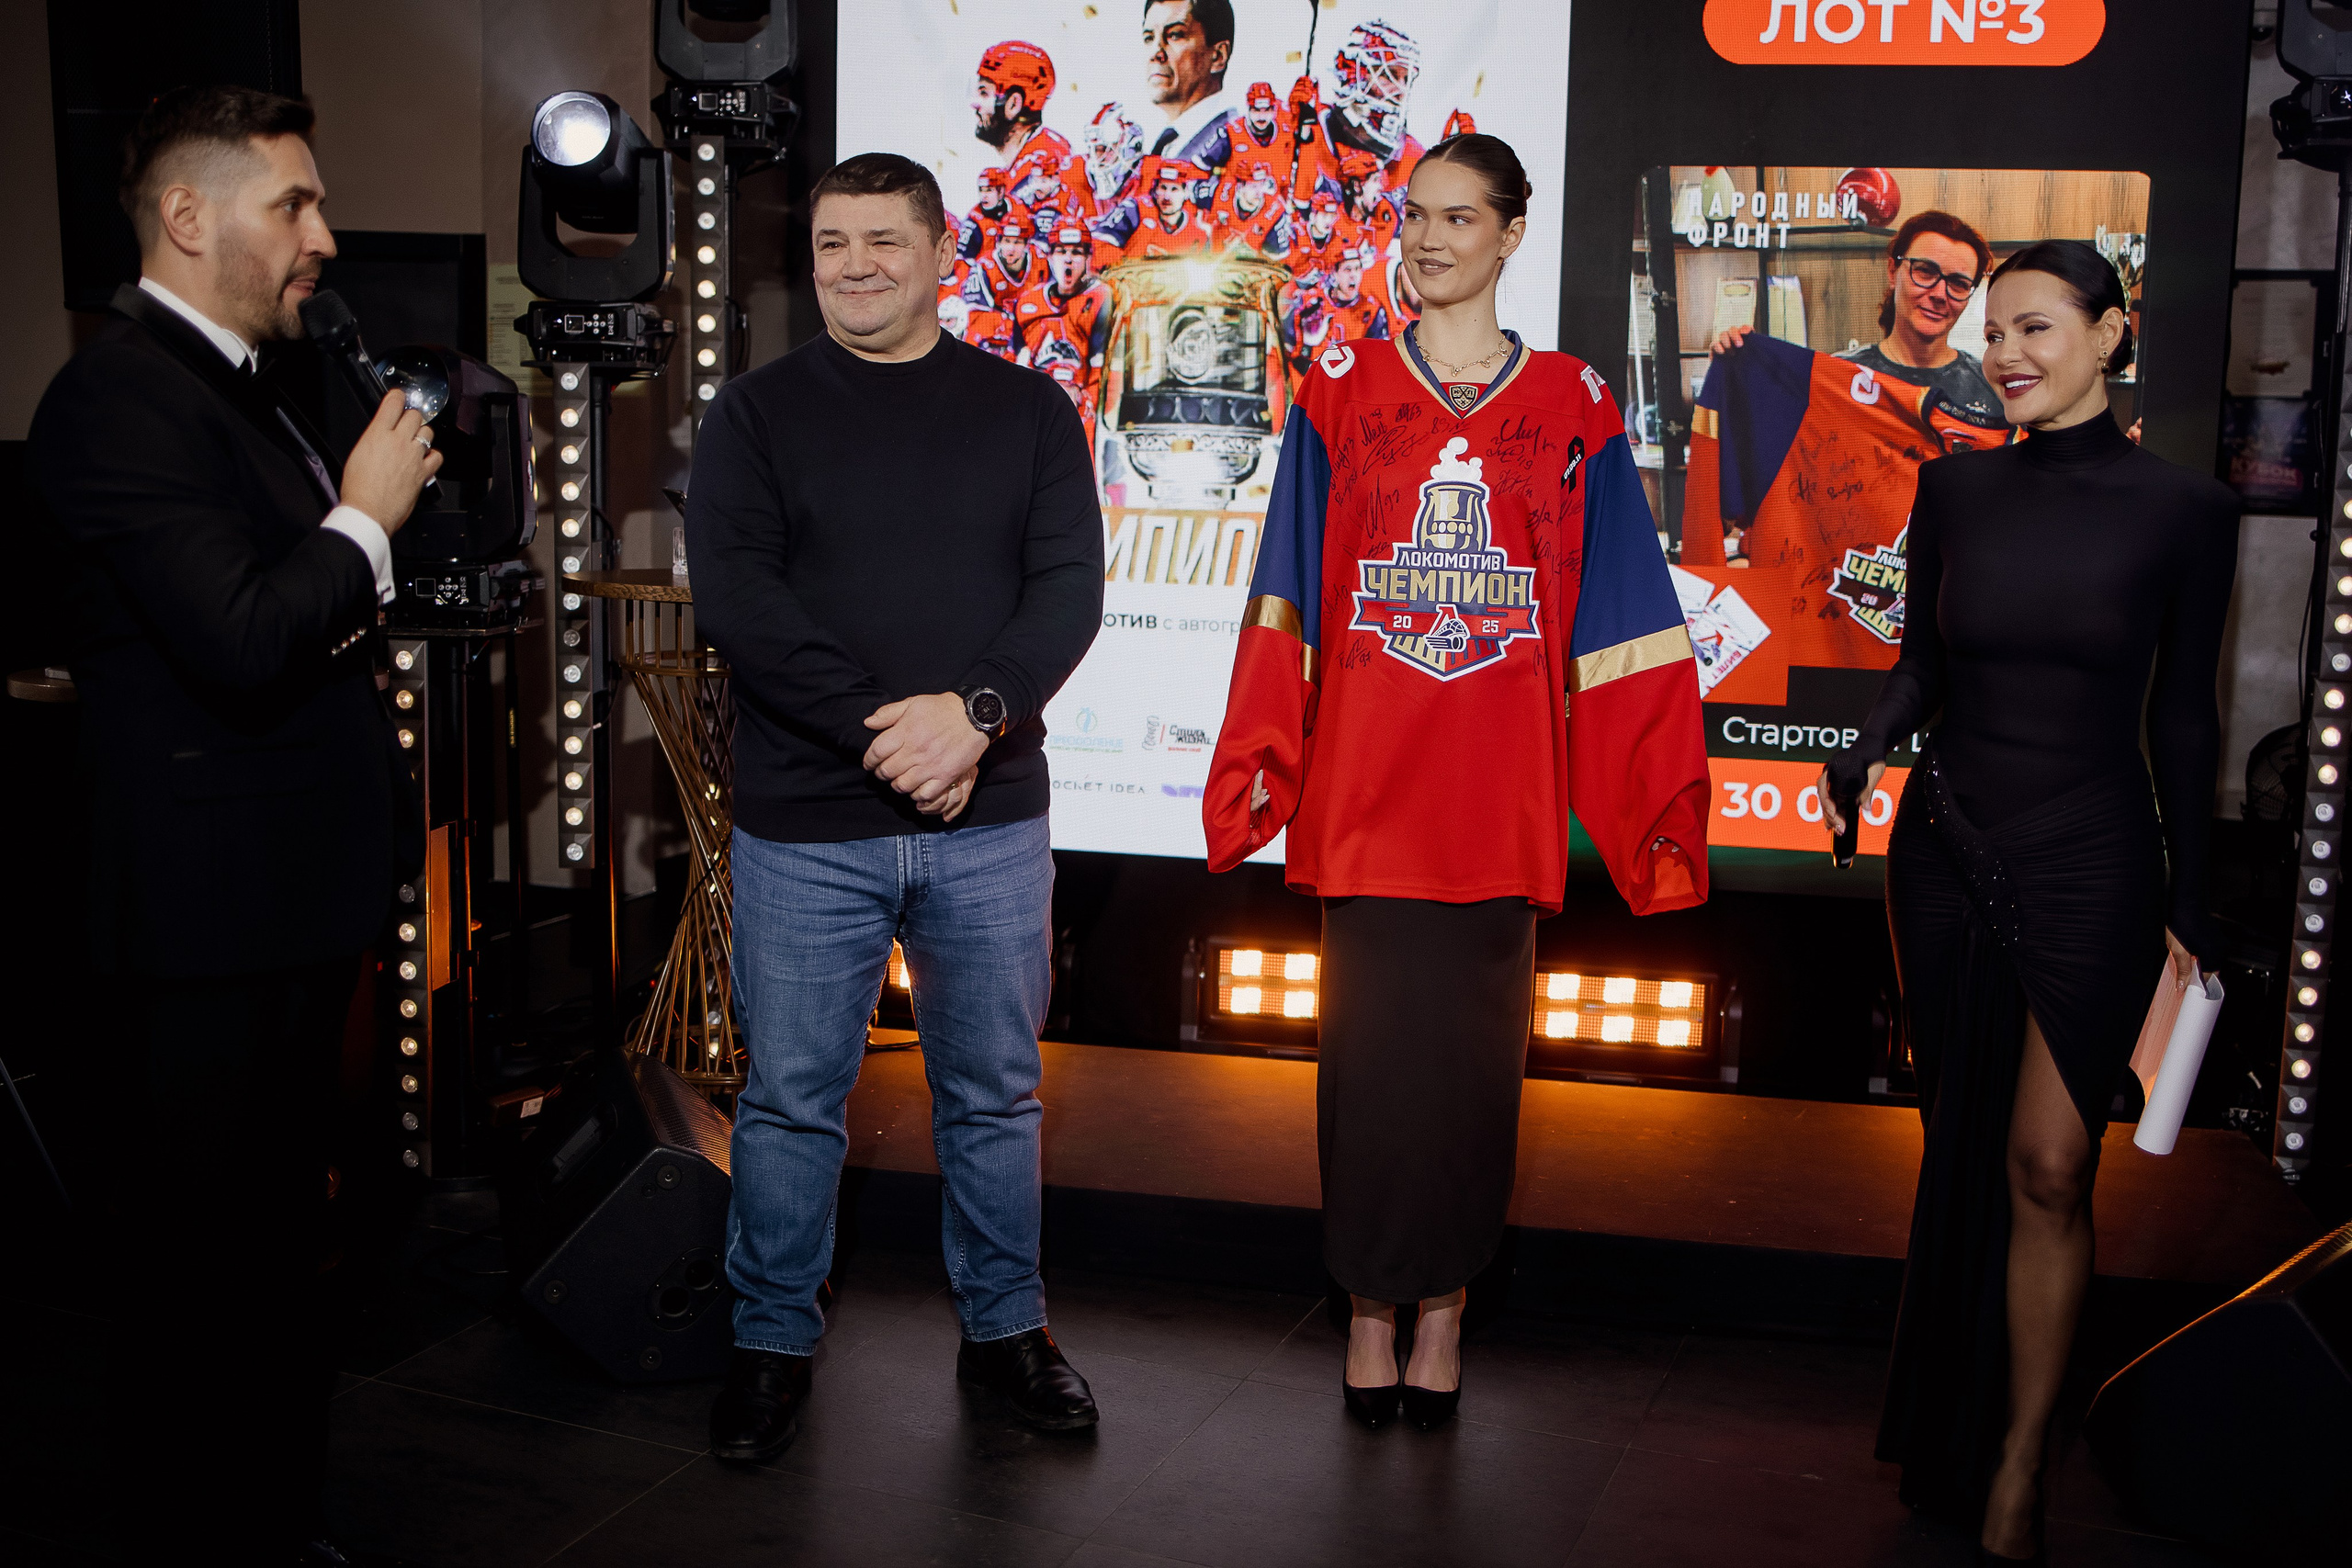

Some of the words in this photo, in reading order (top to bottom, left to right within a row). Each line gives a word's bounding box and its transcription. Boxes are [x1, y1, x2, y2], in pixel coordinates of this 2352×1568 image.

[1758, 0, 1909, 44] ЛОТ
[1929, 0, 2045, 45] №3
[1688, 187, 1859, 222] НАРОДНЫЙ
[1687, 221, 1791, 249] ФРОНТ
[1564, 453, 1582, 479] 07.09.11
[1398, 550, 1501, 571] ЛОКОМОТИВ
[1366, 567, 1529, 606] ЧЕМПИОН
[1102, 613, 1158, 629] ОТИВ
[1179, 618, 1240, 636] автогр
[1393, 615, 1412, 629] 20
[1482, 619, 1499, 634] 25
[1723, 716, 1860, 751] Стартов
[1721, 782, 1782, 820] 30
